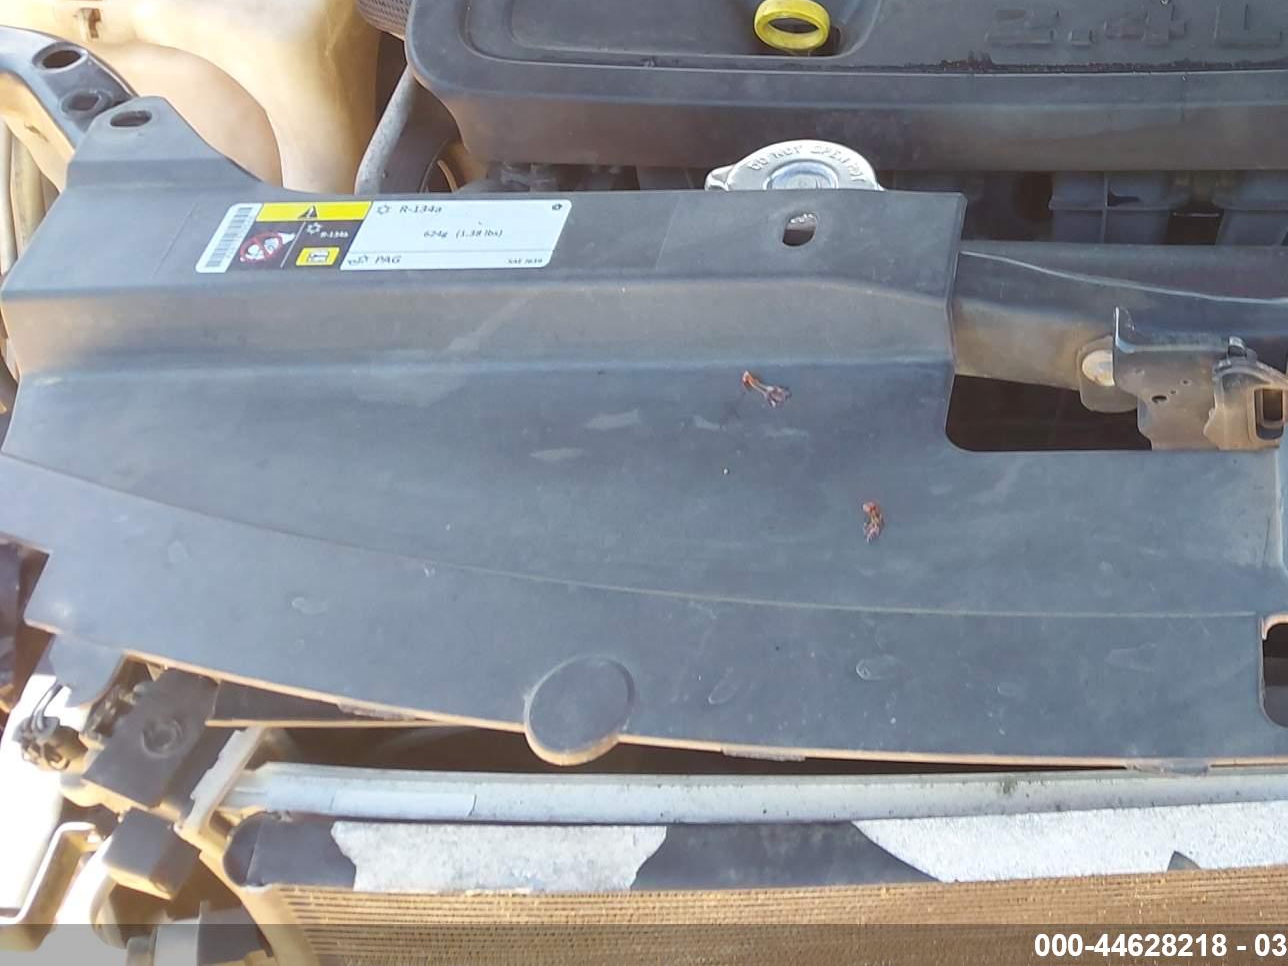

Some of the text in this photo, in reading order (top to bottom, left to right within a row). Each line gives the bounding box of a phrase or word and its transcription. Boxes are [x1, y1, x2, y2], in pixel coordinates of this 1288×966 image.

[399, 205, 443, 214] R-134a
[484, 229, 503, 238] lbs)
[375, 255, 401, 264] PAG
